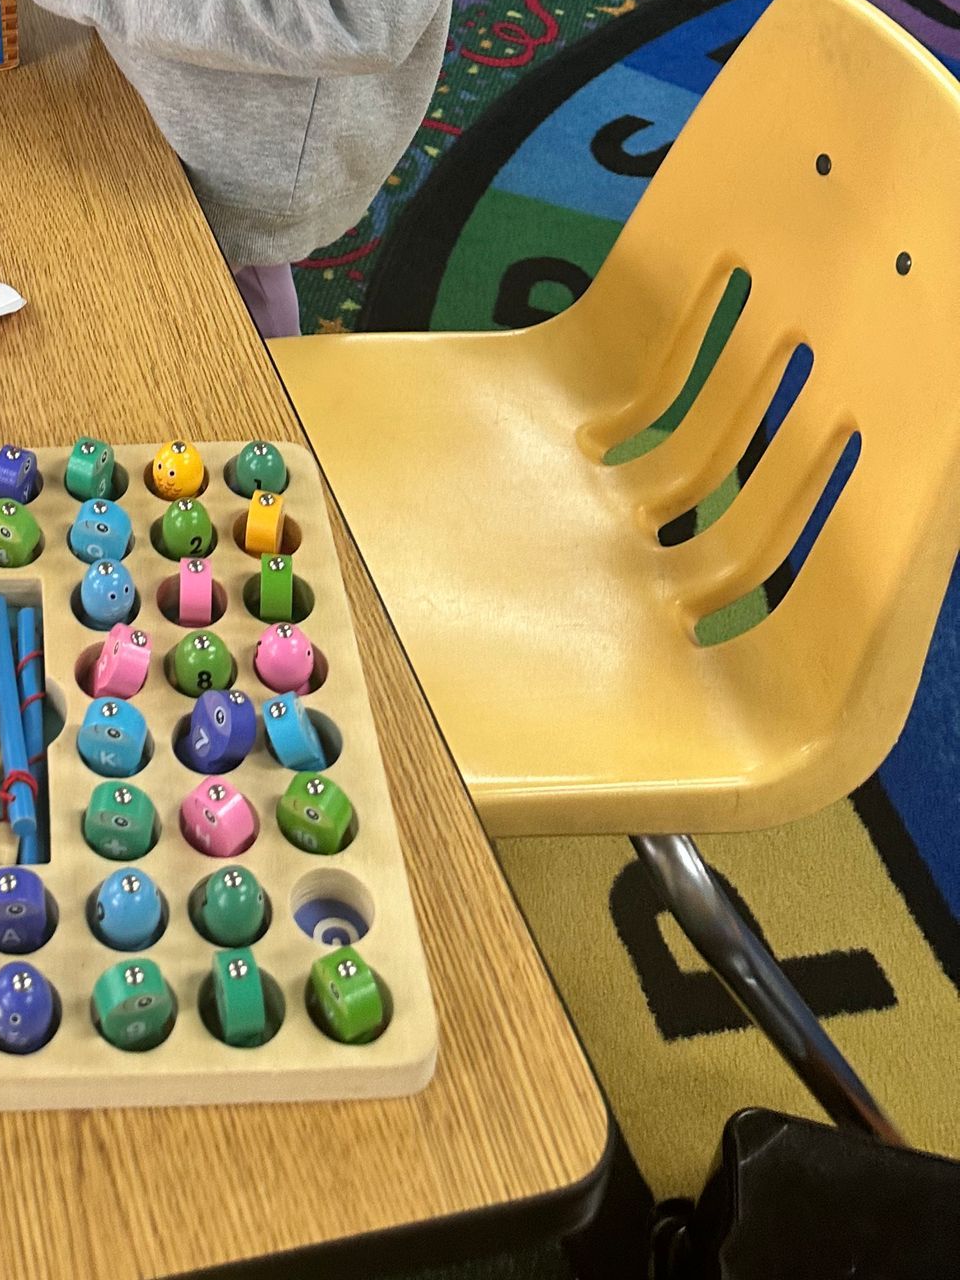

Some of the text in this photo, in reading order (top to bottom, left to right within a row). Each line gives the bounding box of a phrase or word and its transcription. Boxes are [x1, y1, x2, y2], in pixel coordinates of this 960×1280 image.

[190, 536, 202, 555] 2
[196, 670, 212, 690] 8
[100, 750, 116, 766] K
[1, 927, 21, 944] A
